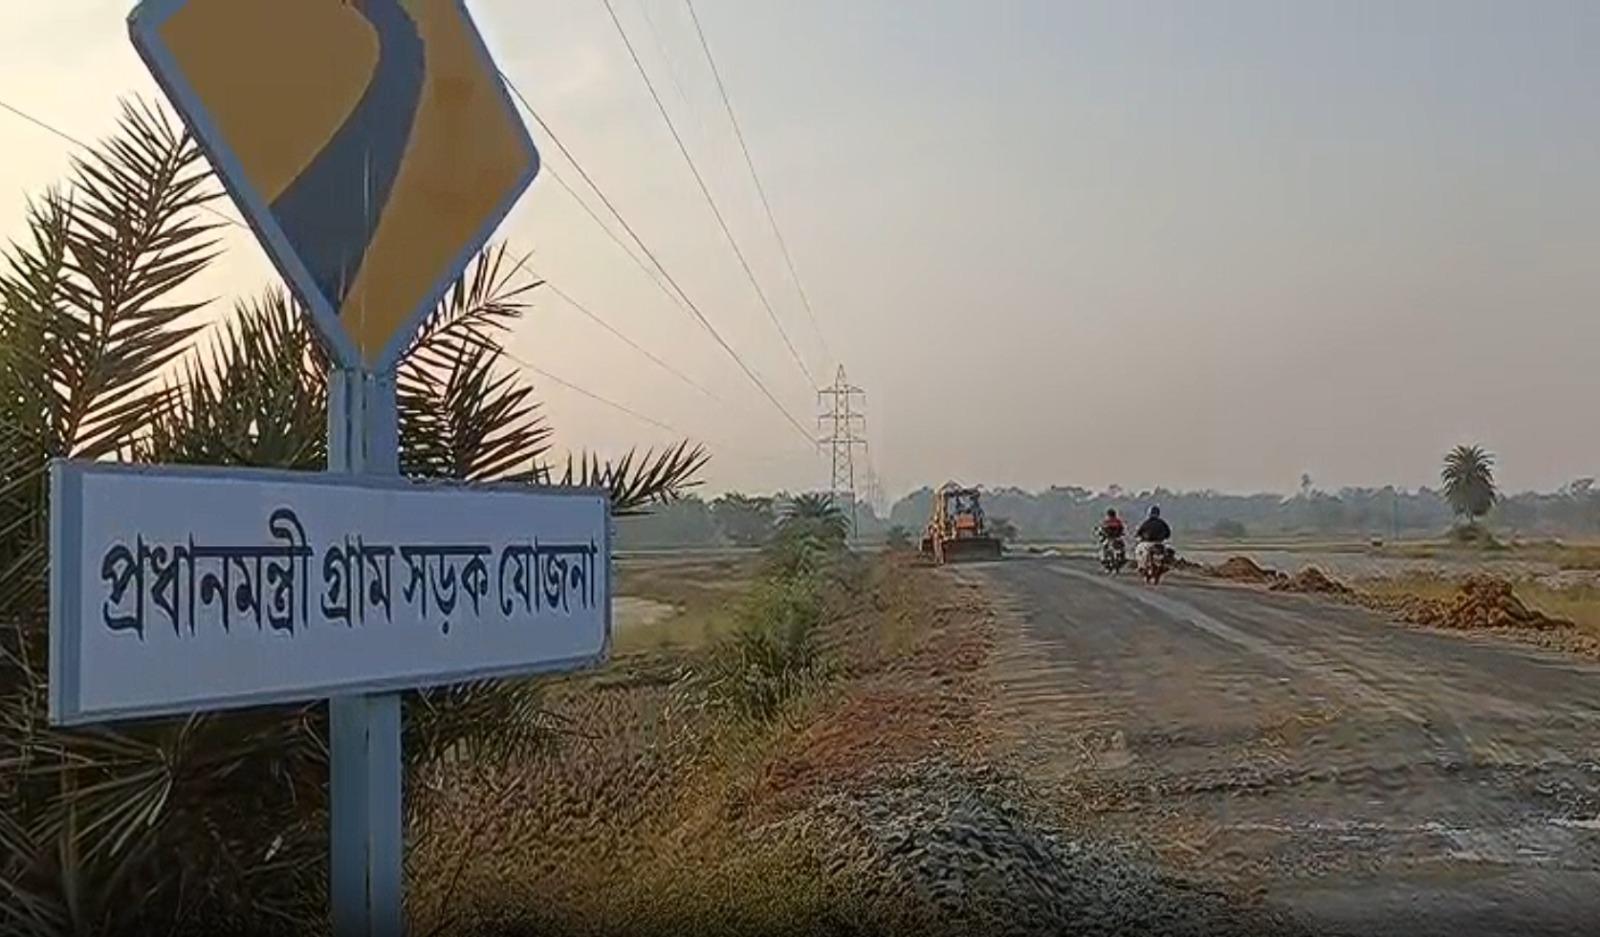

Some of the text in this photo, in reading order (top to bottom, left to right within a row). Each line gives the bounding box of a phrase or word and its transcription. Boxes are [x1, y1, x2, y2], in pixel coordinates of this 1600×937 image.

[102, 508, 598, 639] প্রধানমন্ত্রী গ্রাম সড়ক যোজনা
